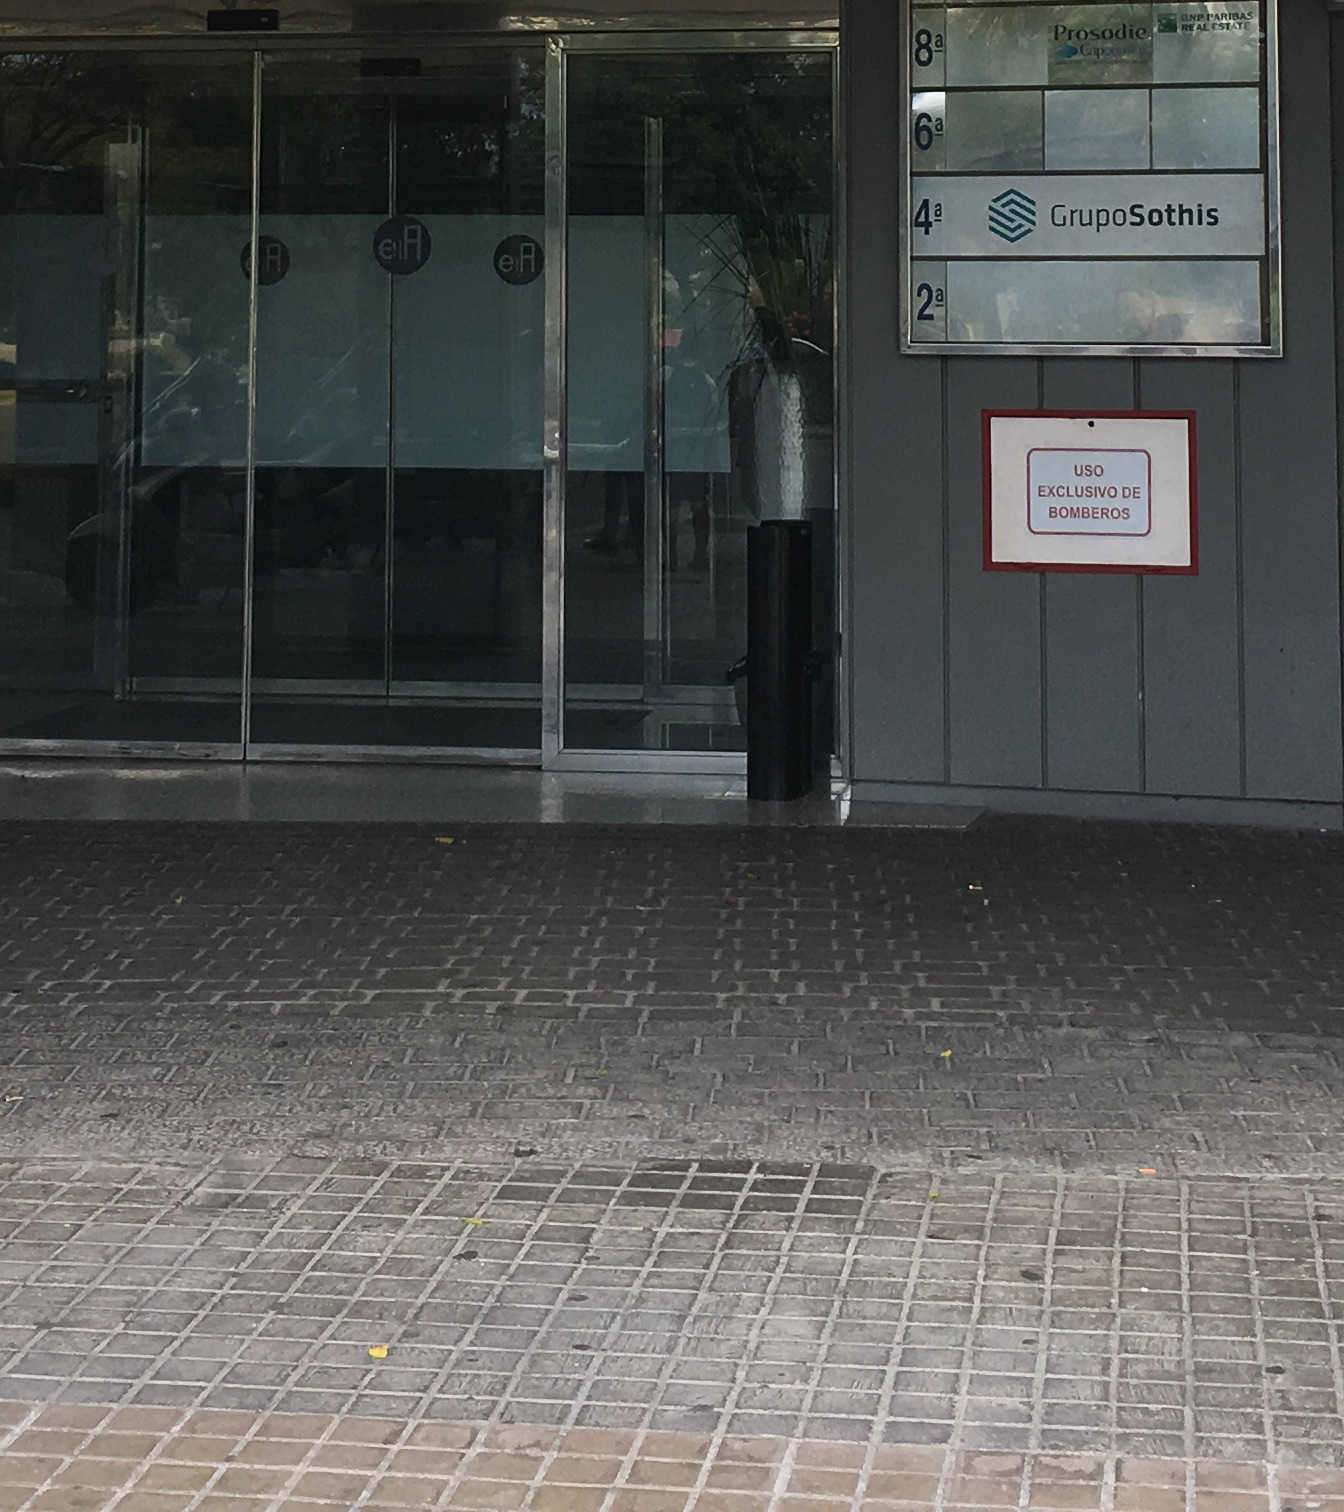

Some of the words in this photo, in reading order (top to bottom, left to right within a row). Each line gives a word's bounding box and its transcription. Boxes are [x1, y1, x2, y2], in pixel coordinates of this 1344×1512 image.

[1207, 11, 1254, 22] PARIBAS
[1052, 22, 1148, 42] Prosodie
[1181, 22, 1210, 32] REAL
[1050, 203, 1219, 233] GrupoSothis
[1074, 464, 1105, 477] USO
[1037, 485, 1118, 499] EXCLUSIVO
[1122, 486, 1141, 500] DE
[1048, 506, 1131, 520] BOMBEROS
